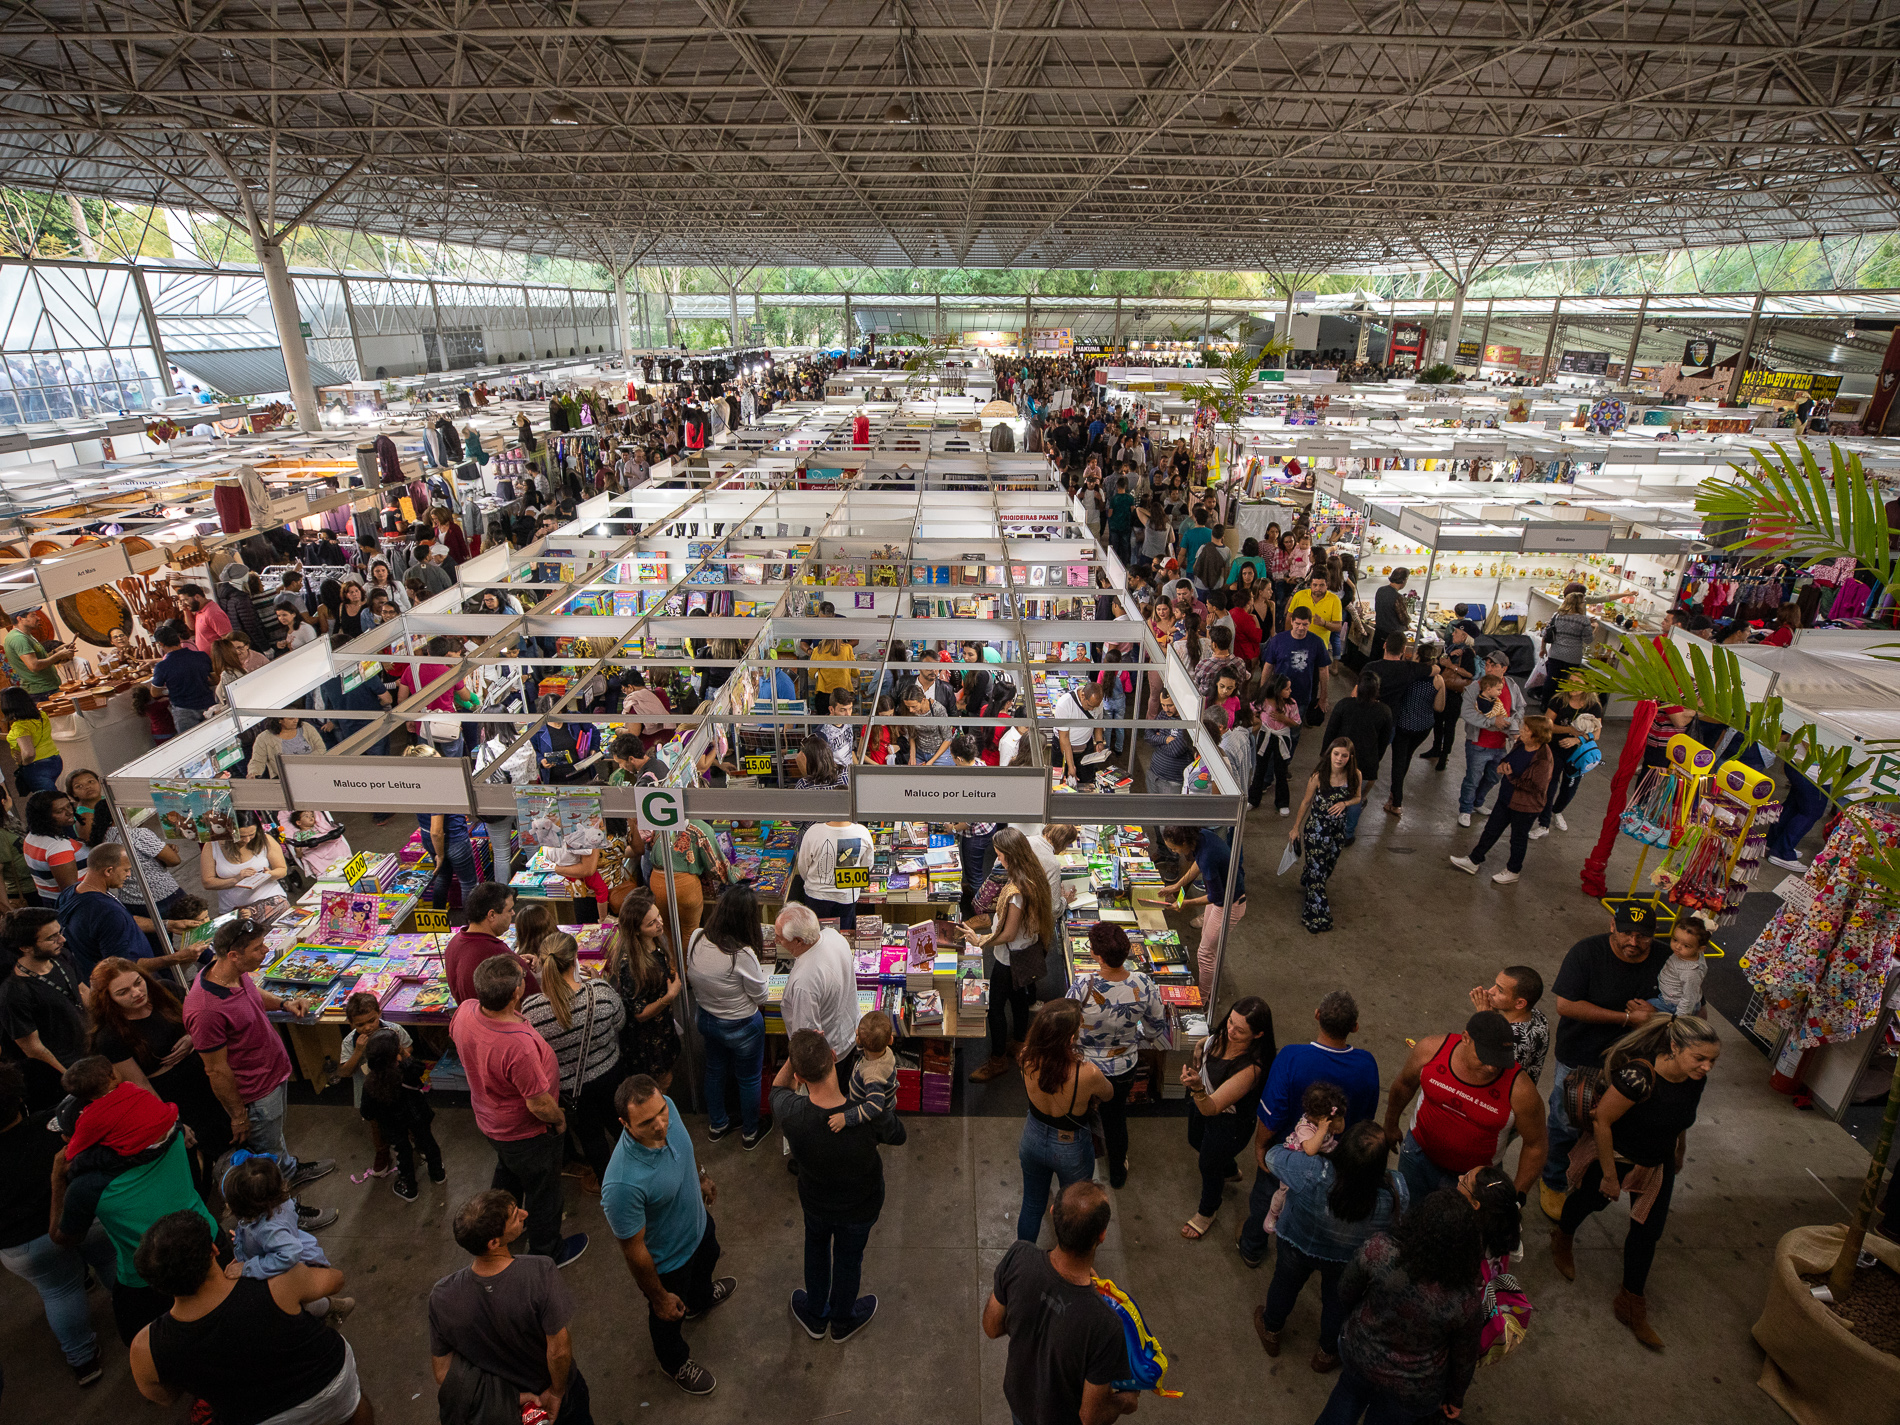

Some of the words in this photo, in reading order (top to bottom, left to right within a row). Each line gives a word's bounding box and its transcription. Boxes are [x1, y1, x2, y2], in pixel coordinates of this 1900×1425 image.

[1363, 503, 1369, 519] D
[745, 759, 771, 771] 15,00
[333, 779, 367, 789] Maluco
[369, 781, 386, 791] por
[388, 780, 421, 790] Leitura
[904, 788, 939, 798] Maluco
[942, 790, 959, 800] por
[962, 788, 996, 798] Leitura
[641, 791, 679, 827] G
[346, 859, 366, 885] 10,00
[836, 871, 869, 885] 15,00
[416, 913, 448, 928] 10,00
[1429, 1077, 1456, 1094] ATIVIDADE
[1456, 1089, 1473, 1103] FÍSICA
